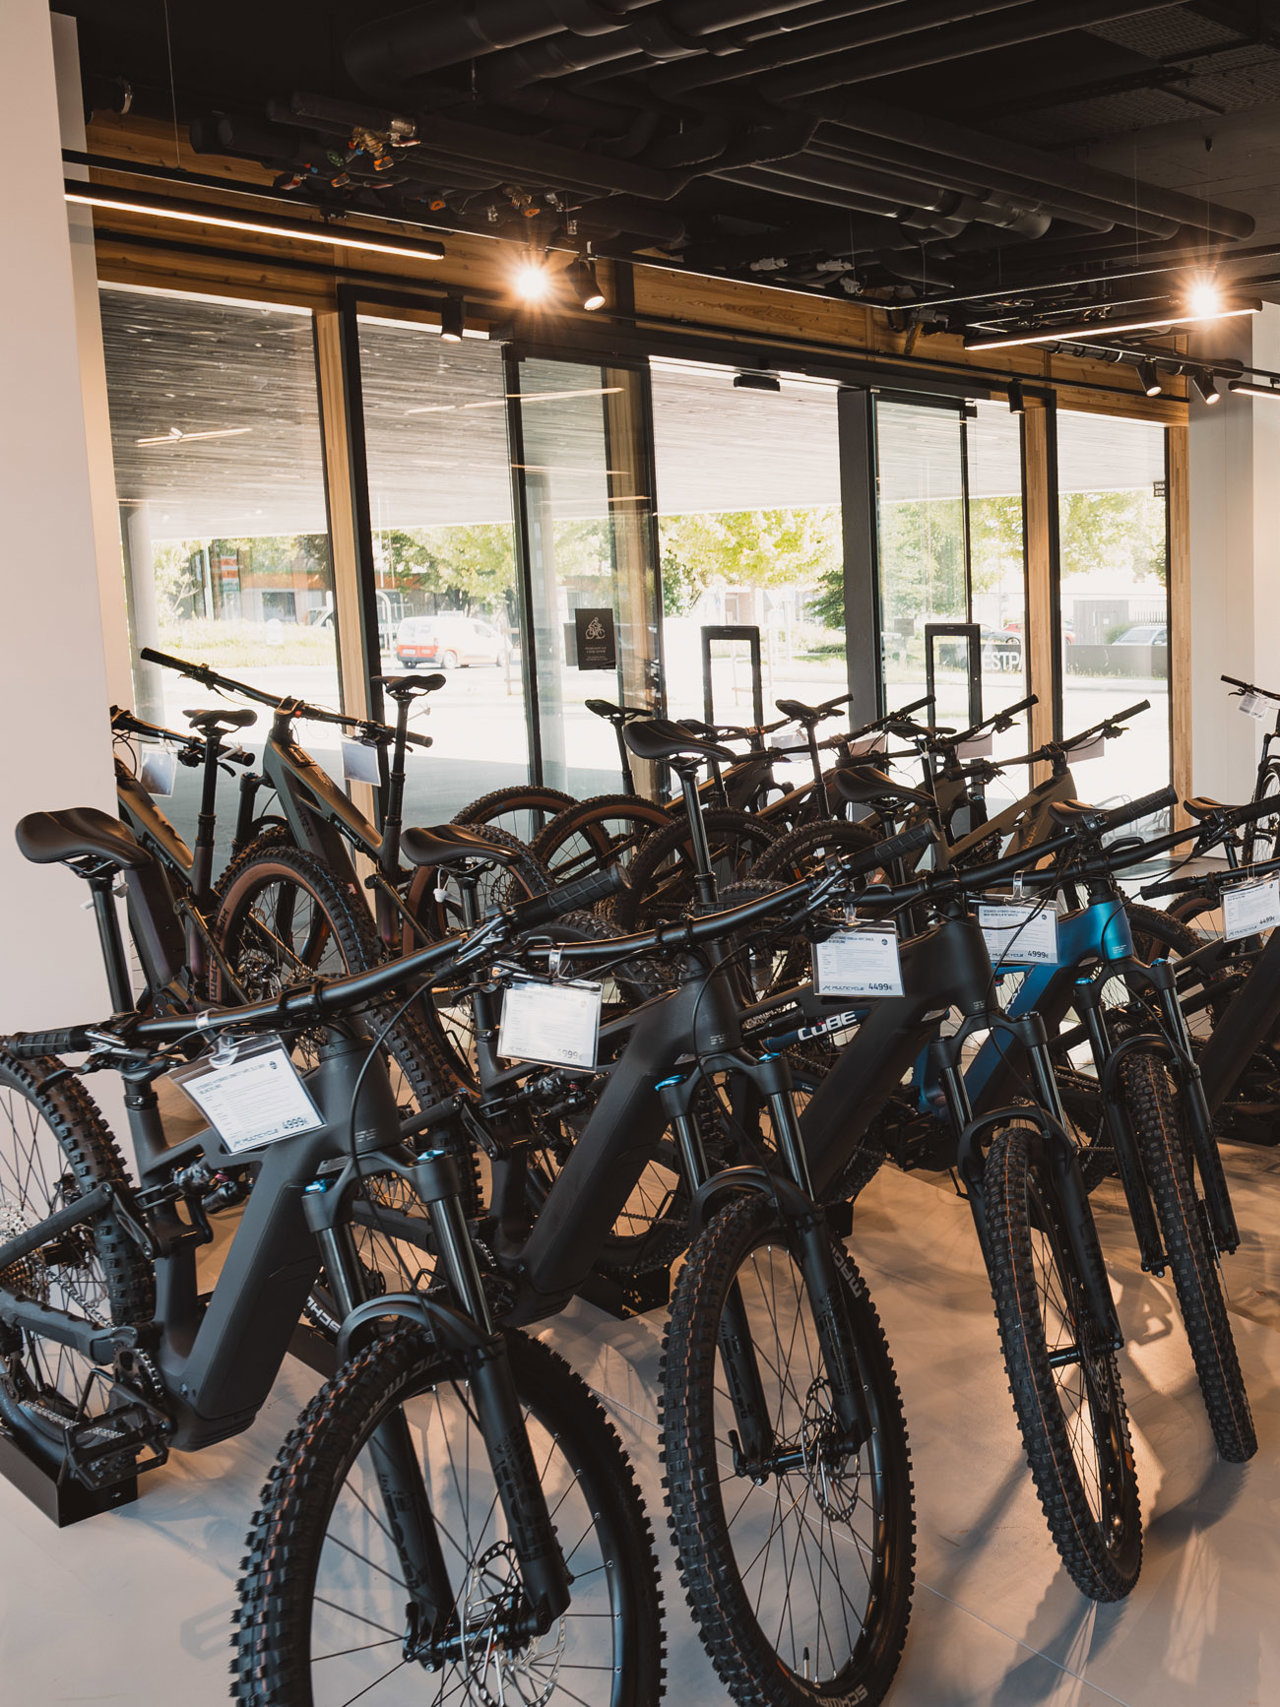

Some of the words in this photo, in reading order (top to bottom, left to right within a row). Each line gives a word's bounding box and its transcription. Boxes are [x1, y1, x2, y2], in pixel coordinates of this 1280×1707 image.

[868, 983, 893, 991] 4499€
[798, 1011, 857, 1041] CUBE
[306, 1295, 342, 1333] SCHW
